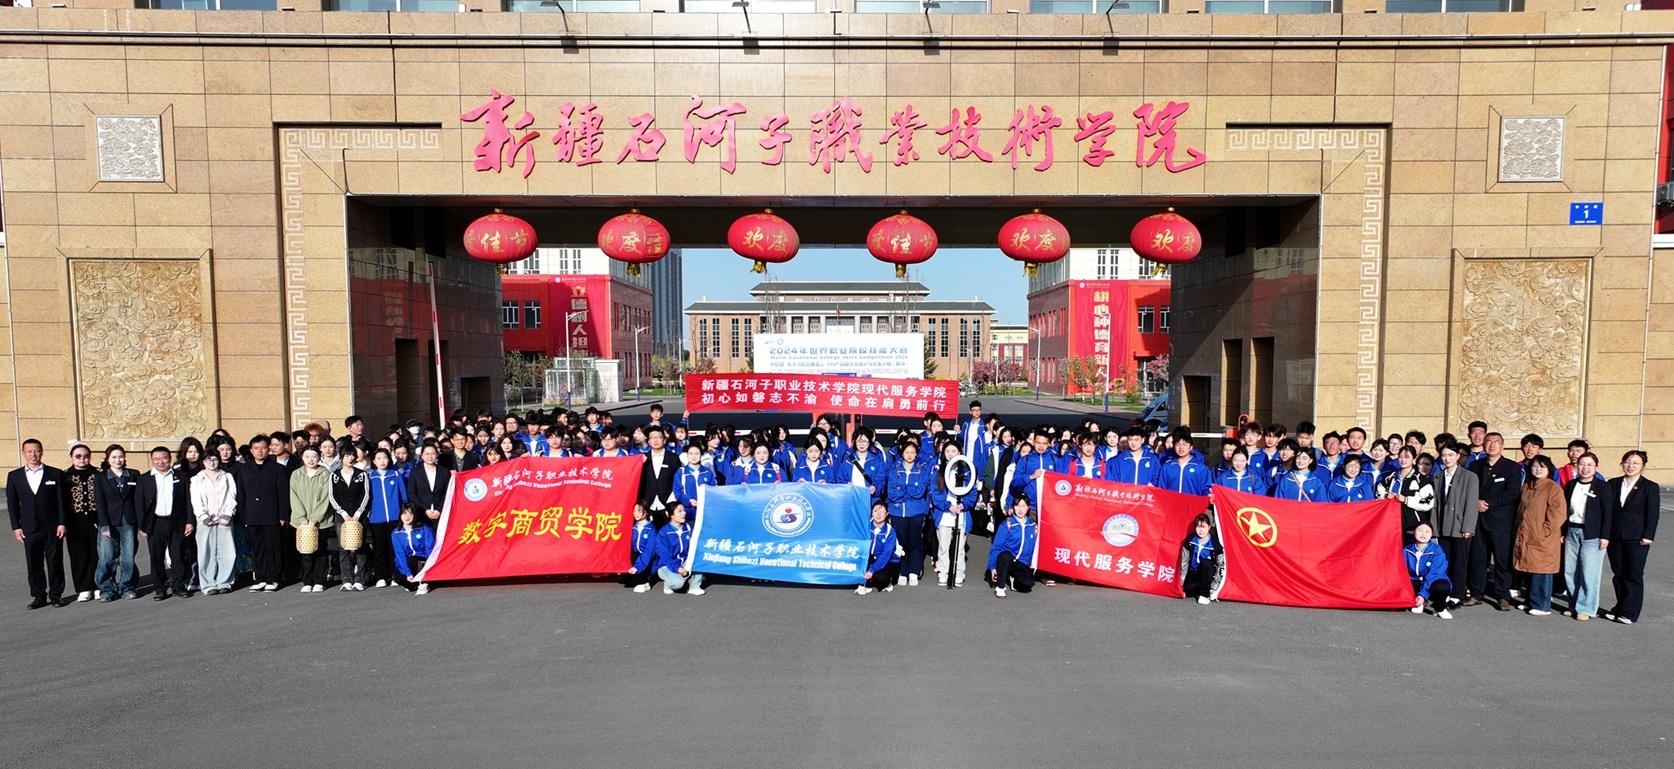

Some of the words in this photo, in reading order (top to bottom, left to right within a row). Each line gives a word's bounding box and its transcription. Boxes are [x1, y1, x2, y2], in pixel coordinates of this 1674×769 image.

[1583, 210, 1589, 219] 1
[1010, 227, 1057, 253] 欢度
[701, 379, 947, 398] 新疆石河子职业技术学院现代服务学院
[701, 391, 818, 405] 初心如磐志不渝
[830, 394, 946, 411] 使命在肩勇前行
[492, 466, 613, 488] 新疆石河子职业技术学院
[458, 506, 622, 545] 数字商贸学院
[703, 538, 860, 559] 新疆石河子职业技术学院
[702, 552, 732, 565] Xinjiang
[732, 555, 759, 565] Shihezi
[759, 557, 797, 568] Vocational
[798, 559, 832, 570] Technical
[1054, 547, 1176, 583] 现代服务学院
